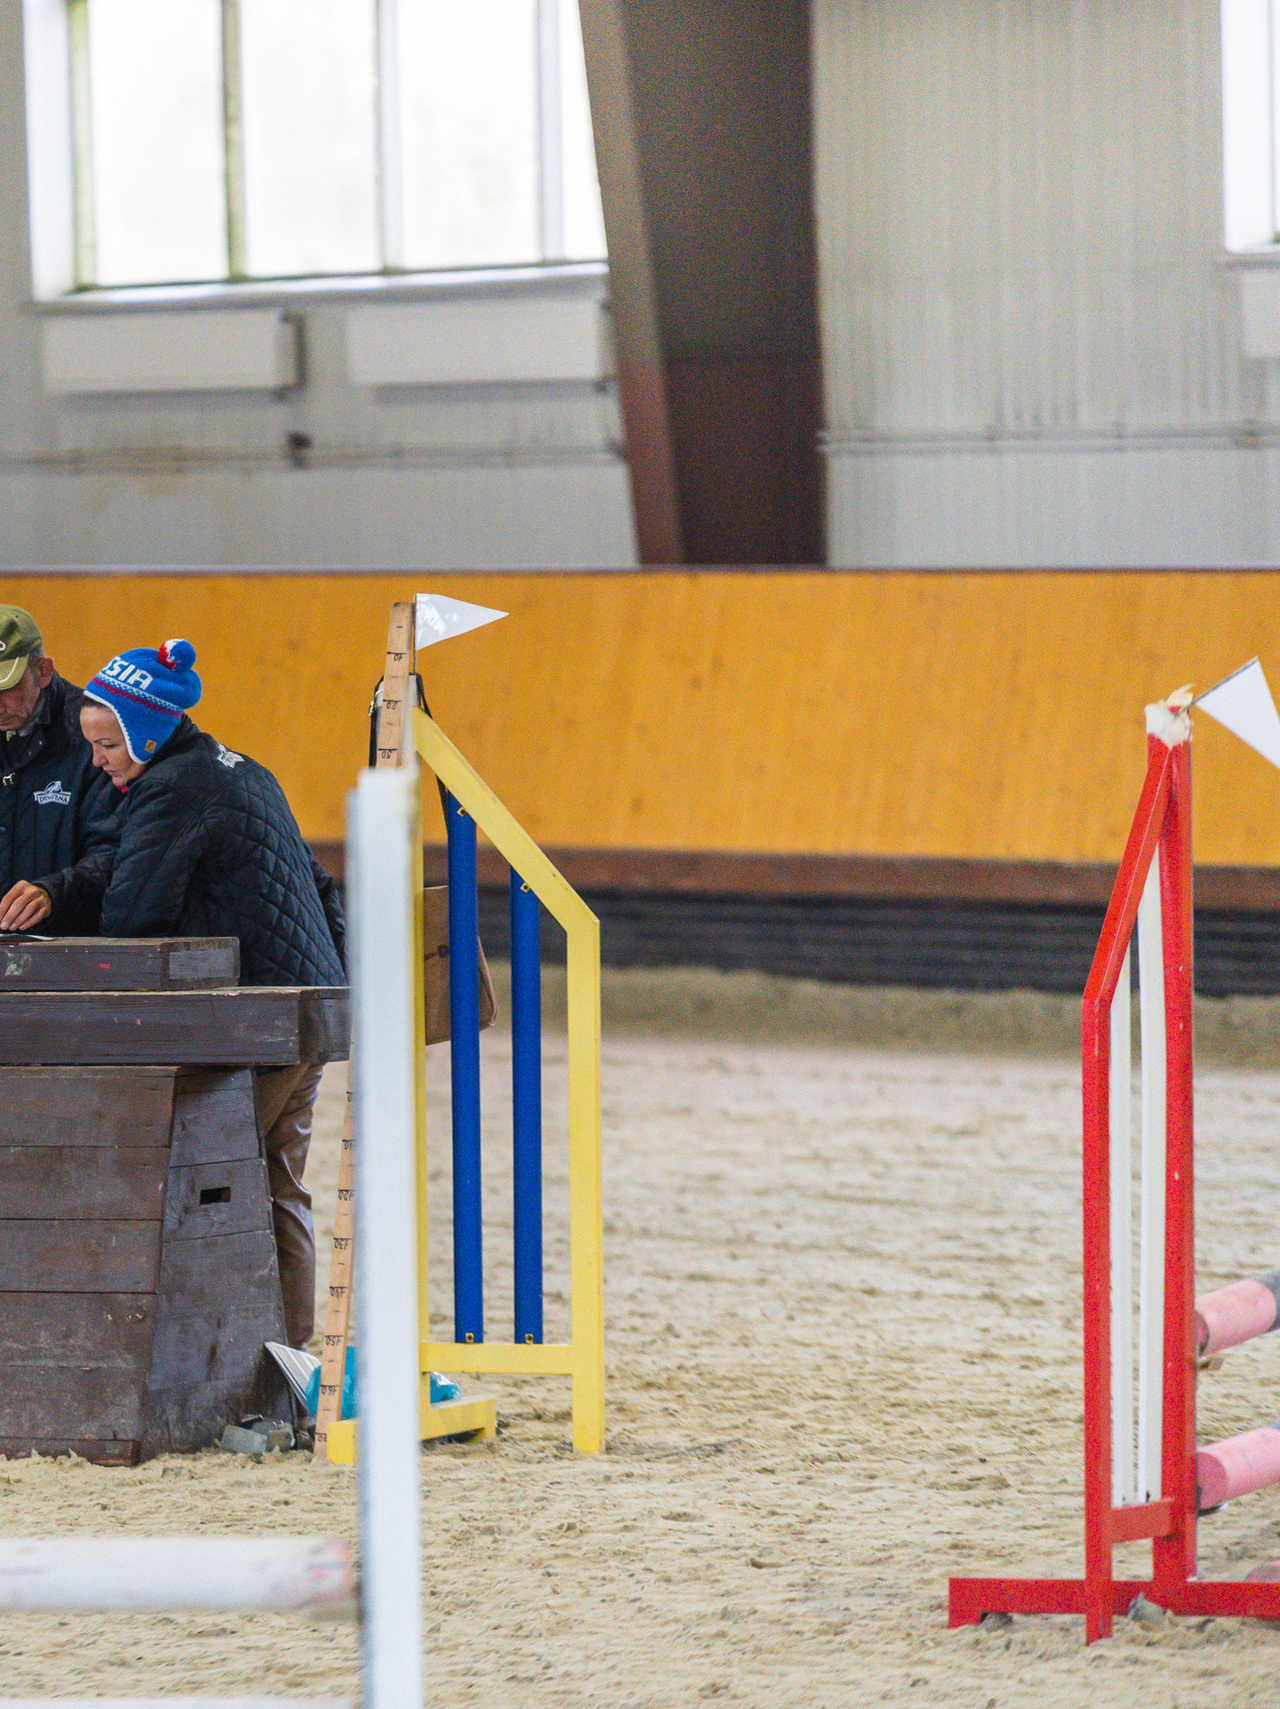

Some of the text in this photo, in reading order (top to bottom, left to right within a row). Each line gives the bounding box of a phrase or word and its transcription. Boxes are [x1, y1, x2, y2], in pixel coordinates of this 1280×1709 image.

[386, 701, 399, 710] 20
[334, 1239, 350, 1249] 130
[326, 1336, 342, 1346] 150
